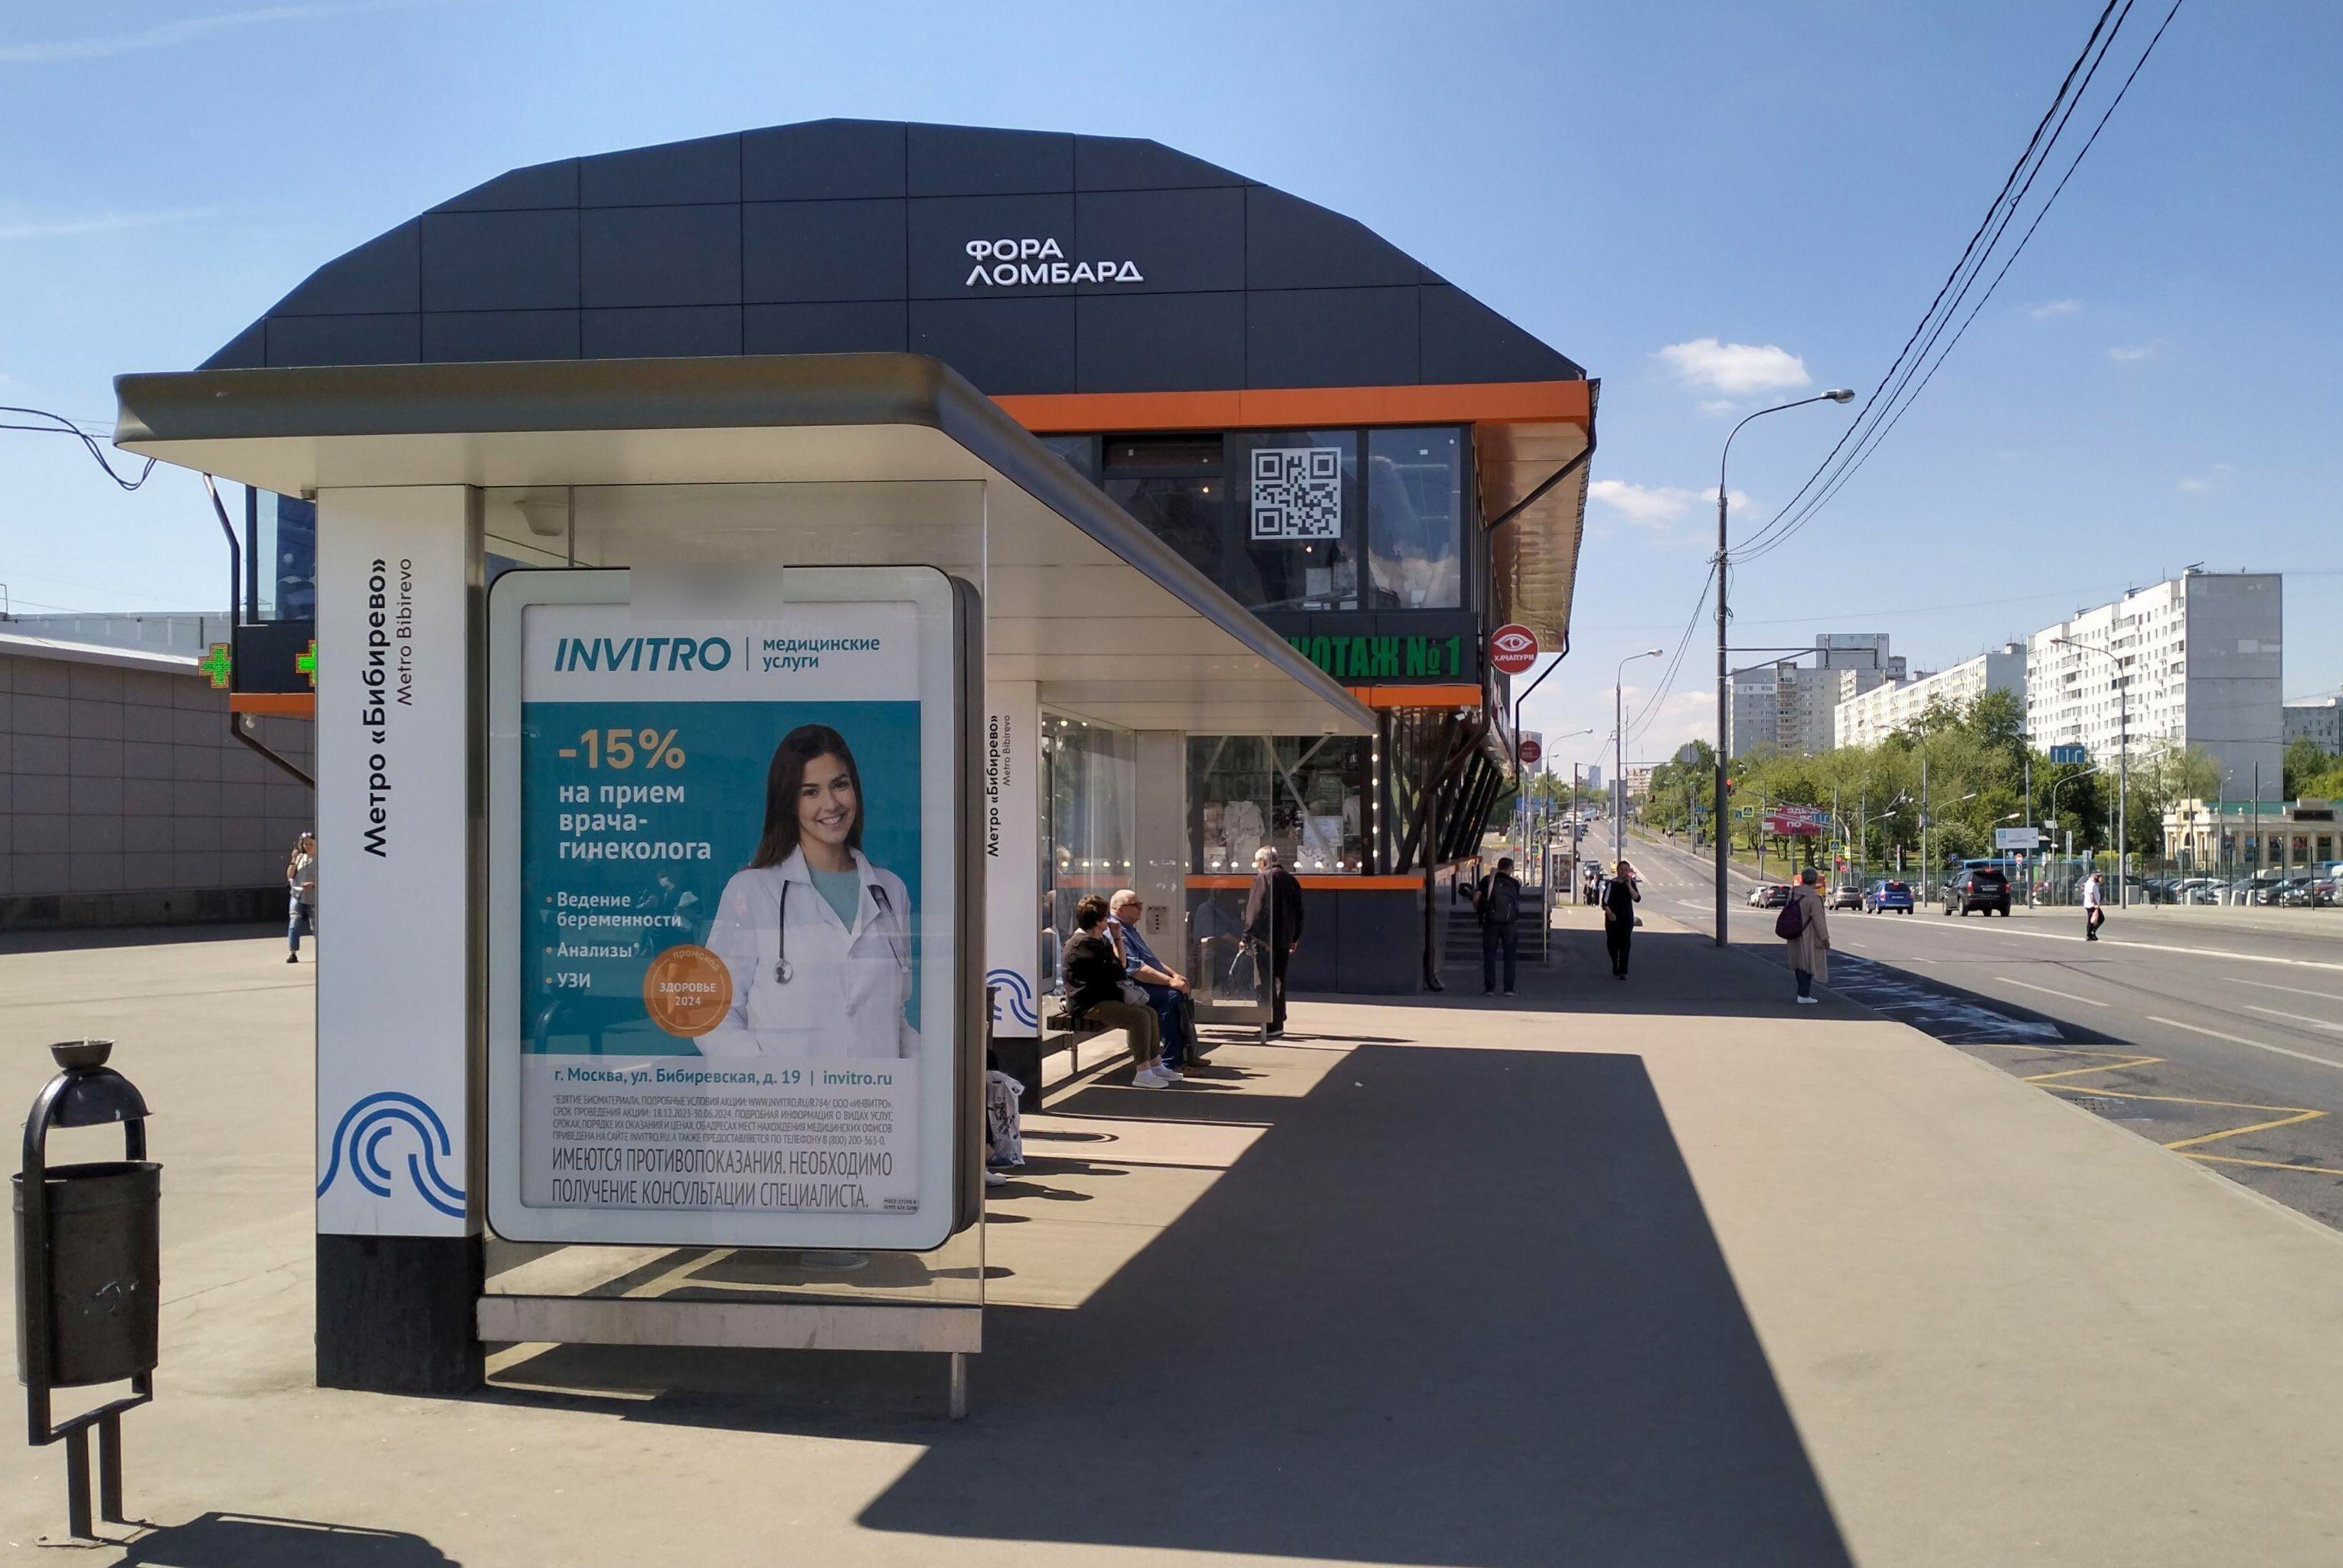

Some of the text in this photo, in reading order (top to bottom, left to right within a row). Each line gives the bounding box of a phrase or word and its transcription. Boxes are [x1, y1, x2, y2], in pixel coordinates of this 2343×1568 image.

[965, 237, 1064, 262] ФОРА
[965, 260, 1145, 287] ЛОМБАРД
[397, 558, 412, 707] Metro Bibirevo
[554, 636, 732, 672] INVITRO
[763, 637, 881, 653] медицинские
[763, 656, 819, 672] услуги
[1494, 653, 1534, 662] ХАЧАПУРИ
[362, 558, 391, 858] Метро «Бибирево»
[1002, 715, 1011, 754] Bibirevo
[558, 728, 686, 769] -15%
[986, 715, 1001, 858] Метро «Бибирево»
[559, 786, 685, 808] на прием
[559, 814, 648, 837] врача-
[559, 841, 711, 859] гинеколога
[557, 891, 631, 910] Ведение
[557, 912, 681, 930] беременности
[672, 949, 720, 972] промокод
[557, 973, 591, 989] УЗИ
[659, 982, 717, 993] ЗДОРОВЬЕ
[675, 996, 701, 1006] 2024
[554, 1068, 801, 1086] г. Москва, ул. Бибиревская, д. 19
[823, 1069, 893, 1086] invitro.ru
[641, 1096, 686, 1106] ПОДРОБНЫЕ
[687, 1097, 719, 1106] УСЛОВИЯ
[553, 1107, 571, 1116] СРОК
[573, 1107, 621, 1117] ПРОВЕДЕНИЯ
[735, 1109, 779, 1119] ПОДРОБНАЯ
[781, 1110, 834, 1120] ИНФОРМАЦИЯ
[844, 1111, 869, 1121] ВИДАХ
[707, 1122, 737, 1131] АДРЕСАХ
[737, 1122, 756, 1132] МЕСТ
[807, 1123, 861, 1133] МЕДИЦИНСКИХ
[862, 1123, 893, 1133] ОФИСОВ
[553, 1131, 595, 1141] ПРИВЕДЕНА
[596, 1132, 606, 1141] НА
[607, 1131, 629, 1142] САЙТЕ
[678, 1133, 702, 1142] ТАКЖЕ
[771, 1134, 782, 1143] ПО
[783, 1135, 821, 1145] ТЕЛЕФОНУ
[828, 1135, 847, 1146] (800)
[553, 1147, 893, 1179] ИМЕЮТСЯ ПРОТИВОПОКАЗАНИЯ. НЕОБХОДИМО
[553, 1178, 870, 1210] ПОЛУЧЕНИЕ КОНСУЛЬТАЦИИ СПЕЦИАЛИСТА.
